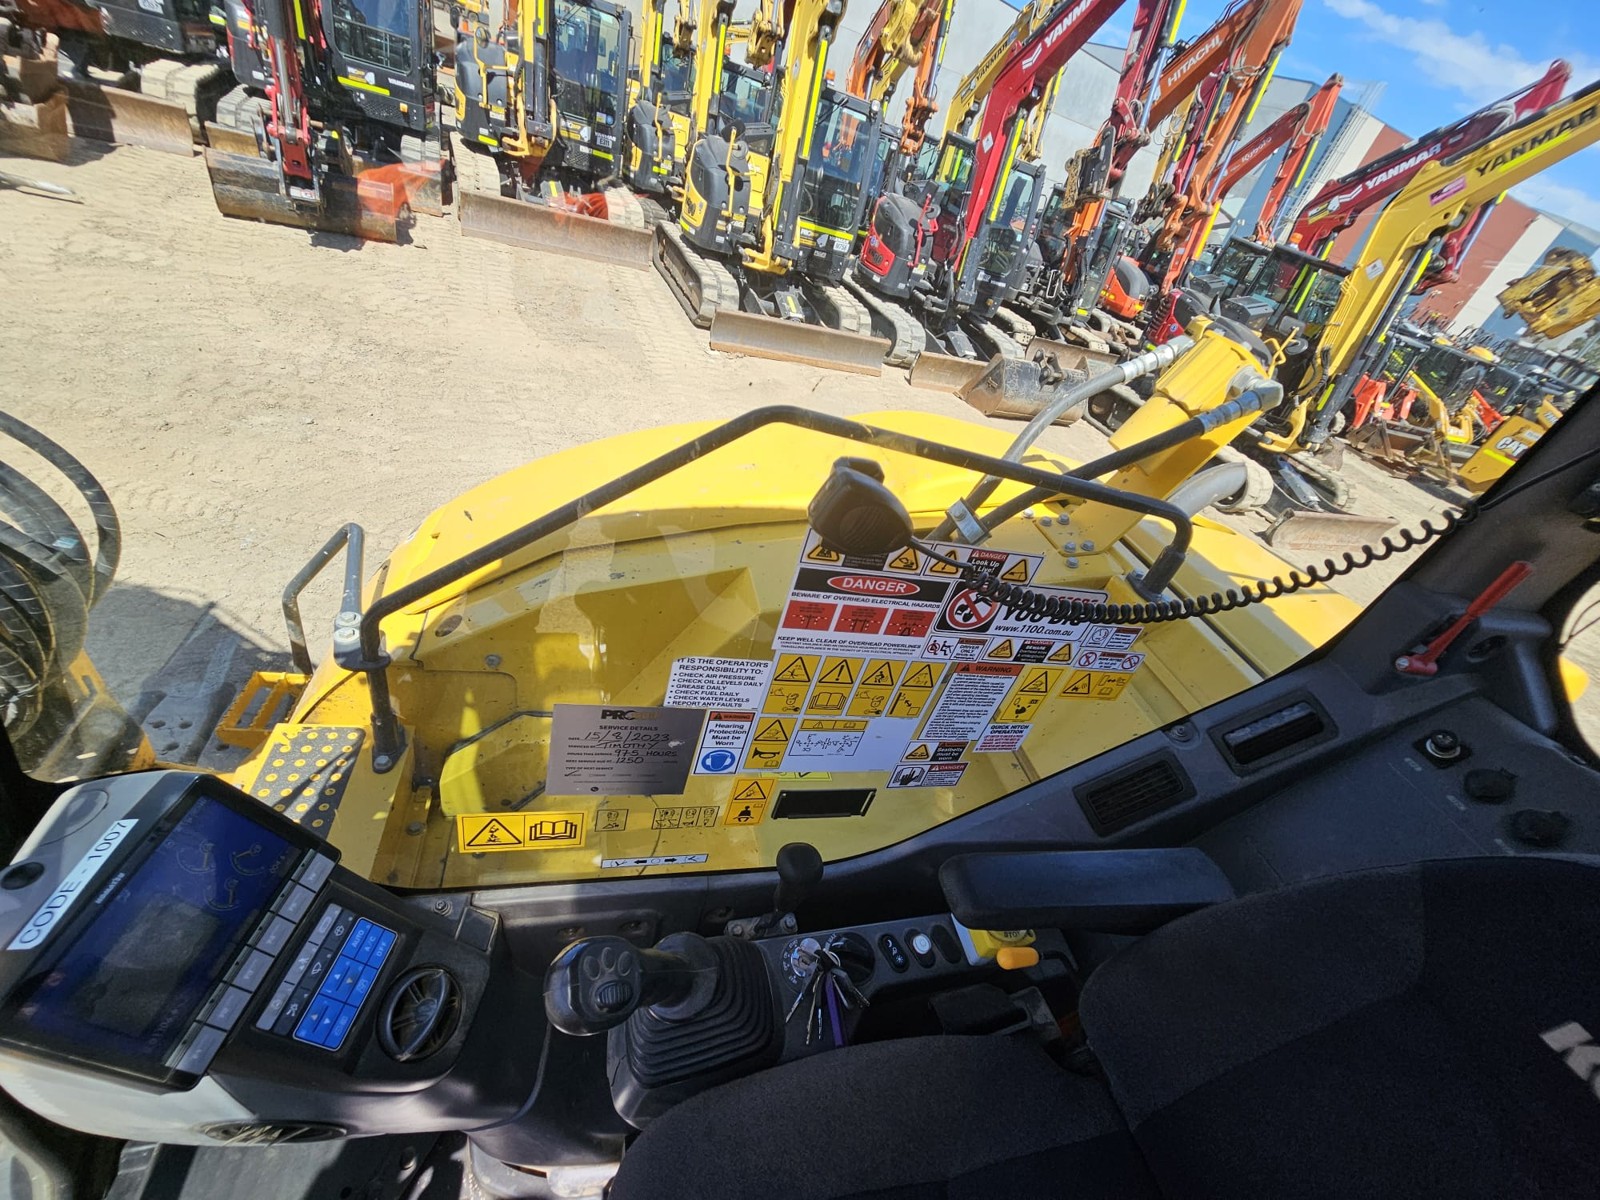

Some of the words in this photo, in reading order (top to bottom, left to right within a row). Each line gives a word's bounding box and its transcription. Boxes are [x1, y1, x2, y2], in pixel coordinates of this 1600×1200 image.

[1168, 35, 1220, 87] HITACHI
[1476, 105, 1598, 178] YANMAR
[1365, 143, 1442, 189] YANMAR
[1496, 436, 1529, 457] CAT
[979, 552, 1007, 560] DANGER
[842, 577, 908, 593] DANGER
[791, 591, 820, 599] BEWARE
[833, 595, 870, 603] OVERHEAD
[871, 598, 910, 607] ELECTRICAL
[994, 624, 1073, 637] www.1100.com.au
[679, 665, 750, 674] RESPONSIBILITY
[716, 659, 769, 668] OPERATOR'S
[975, 665, 1012, 673] WARNING
[615, 756, 645, 764] 1250
[19, 881, 83, 943] CODE
[87, 822, 127, 861] 1007
[351, 929, 365, 948] AUTO
[364, 935, 376, 952] A/C
[376, 941, 387, 957] OFF
